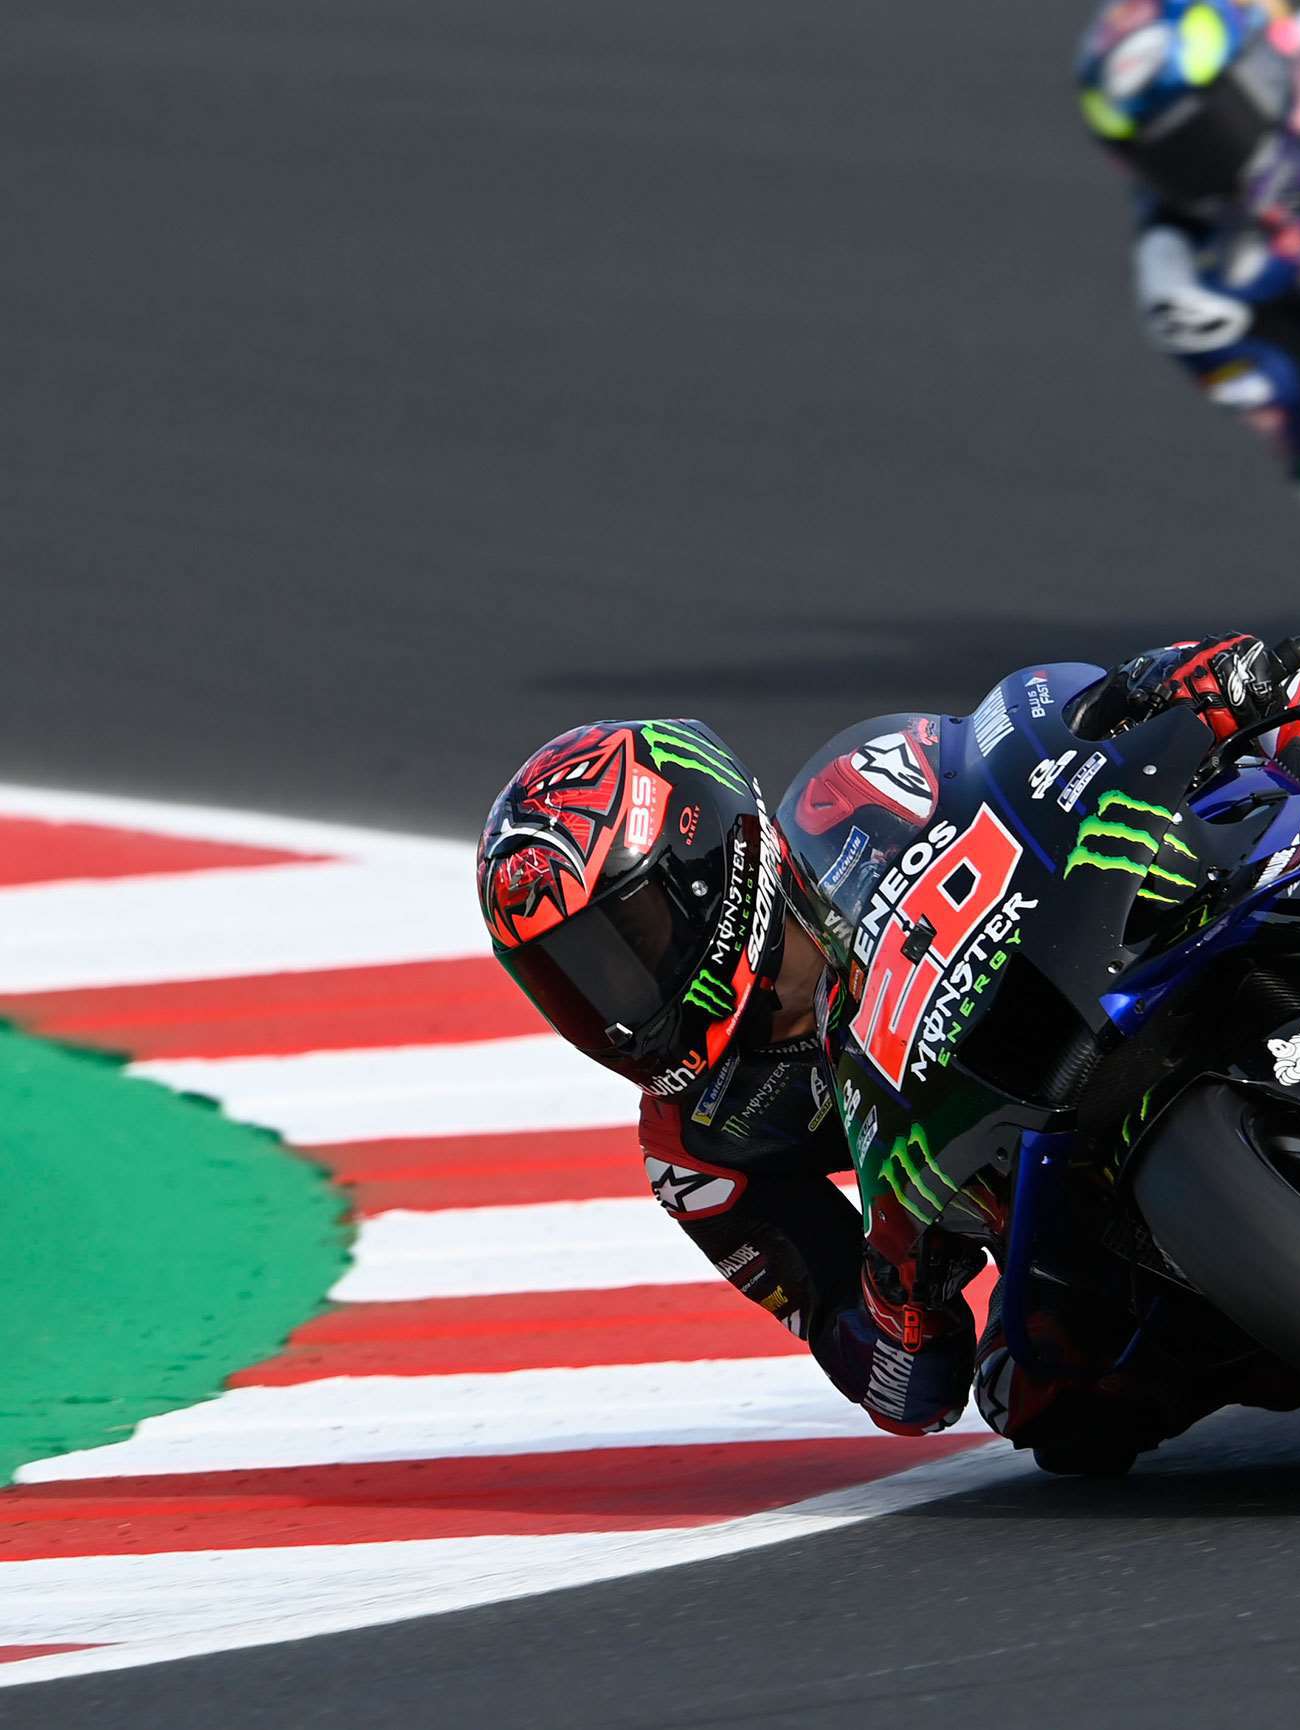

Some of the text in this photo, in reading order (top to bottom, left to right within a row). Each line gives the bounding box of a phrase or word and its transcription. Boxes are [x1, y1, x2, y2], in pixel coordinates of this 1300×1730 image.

[1036, 684, 1054, 705] FAST
[627, 773, 650, 846] BS
[685, 804, 701, 846] OAKLEY
[711, 838, 747, 965] MONSTER
[830, 837, 864, 883] MICHELIN
[853, 819, 958, 966] ENEOS
[734, 864, 755, 952] ENERGY
[849, 801, 1024, 1092] 20
[910, 892, 1039, 1082] MONSTER
[937, 927, 1023, 1067] ENERGY
[741, 1061, 790, 1119] MONSTER
